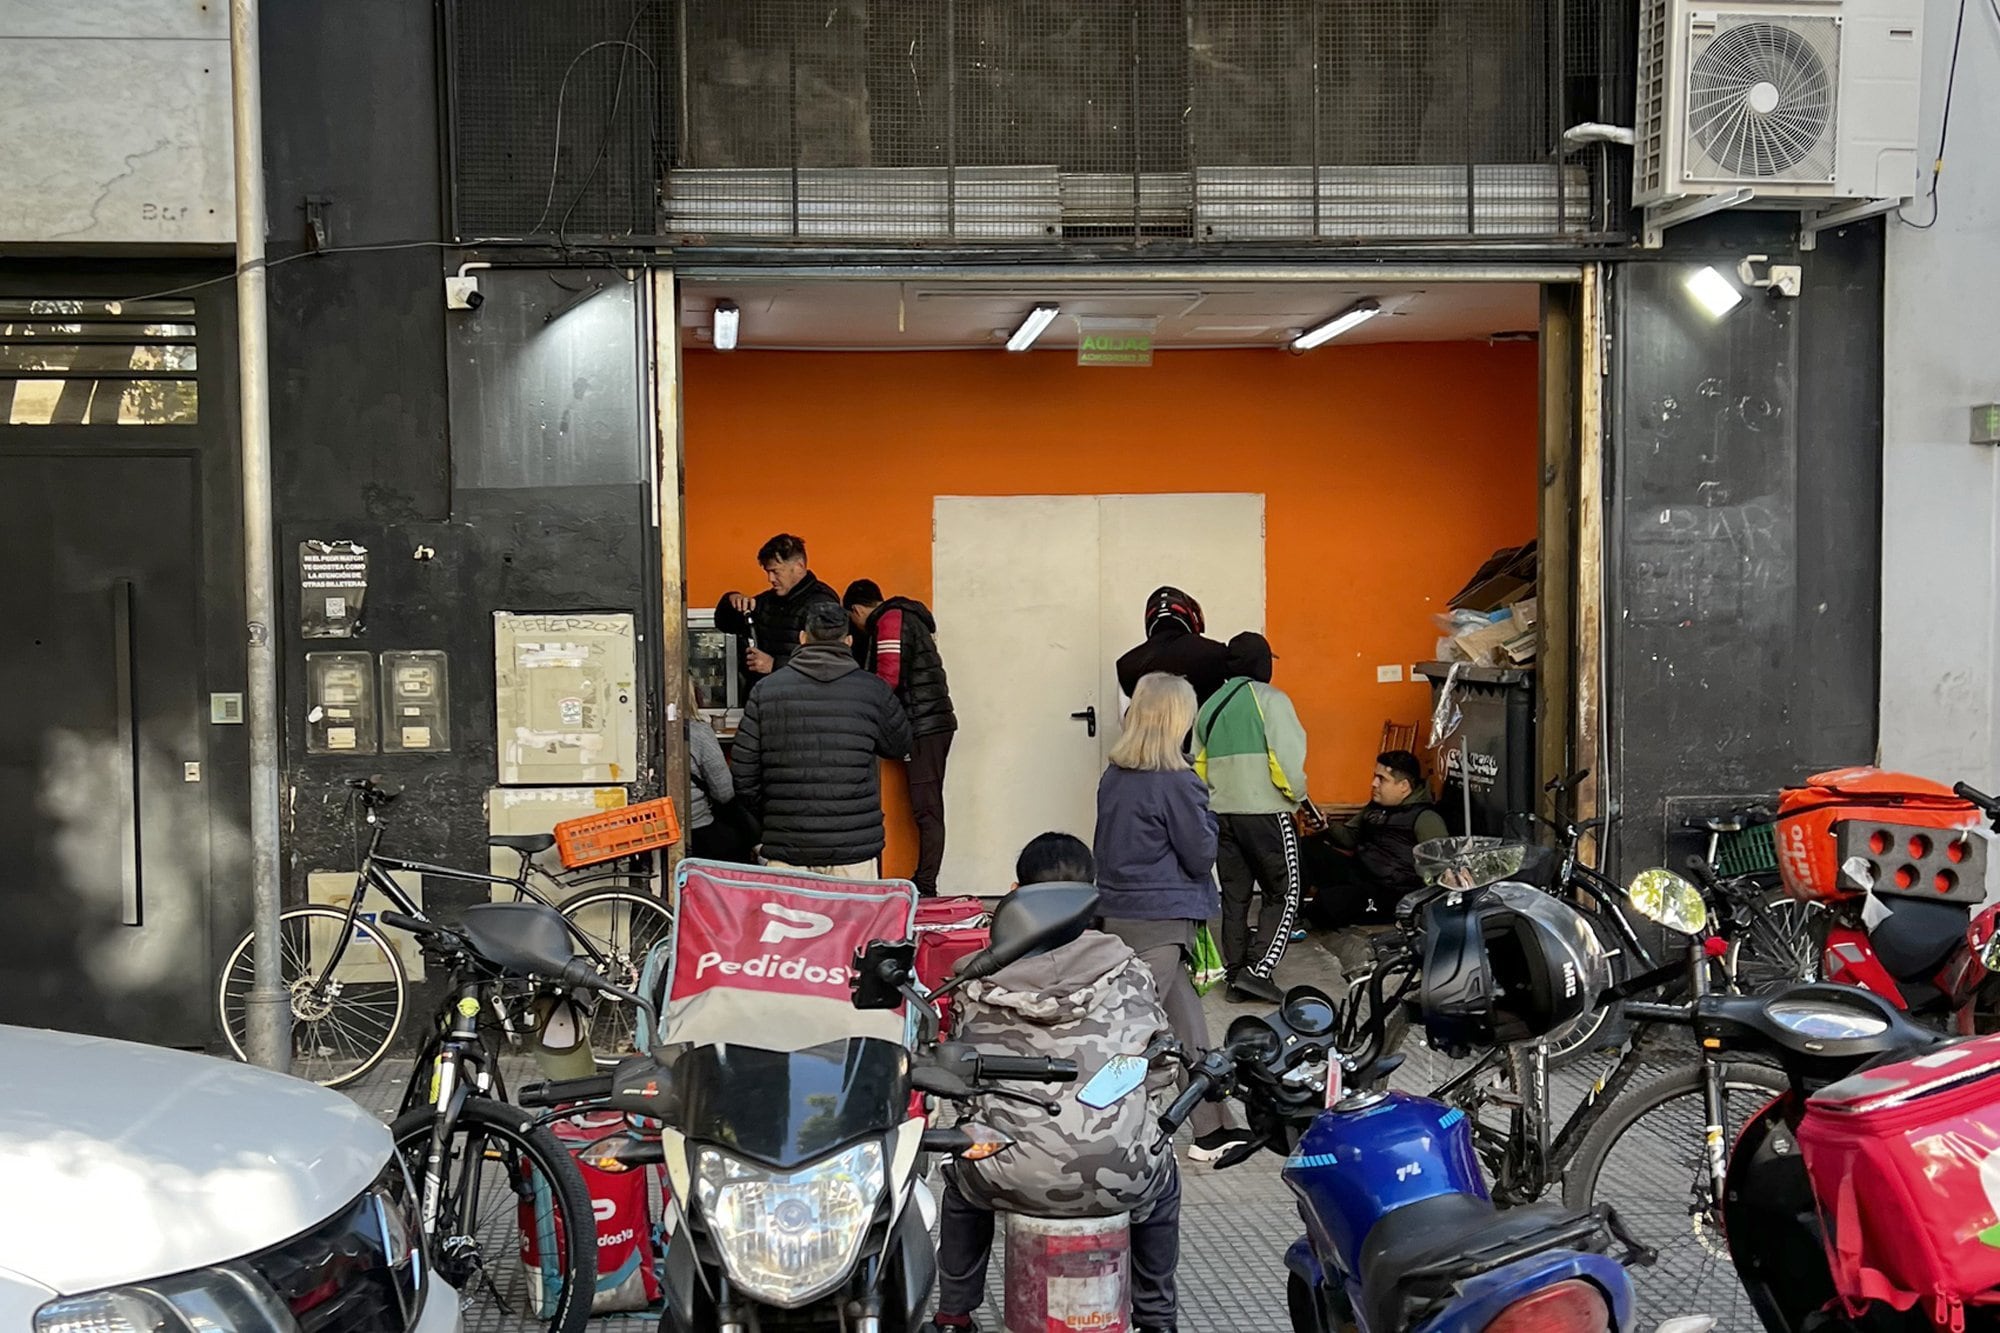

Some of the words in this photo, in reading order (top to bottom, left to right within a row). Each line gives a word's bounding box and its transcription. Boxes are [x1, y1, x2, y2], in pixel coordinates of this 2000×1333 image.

[696, 952, 851, 985] Pedidos
[1562, 961, 1577, 998] MAC
[597, 1229, 634, 1247] dosYa
[1066, 1311, 1118, 1329] signia
